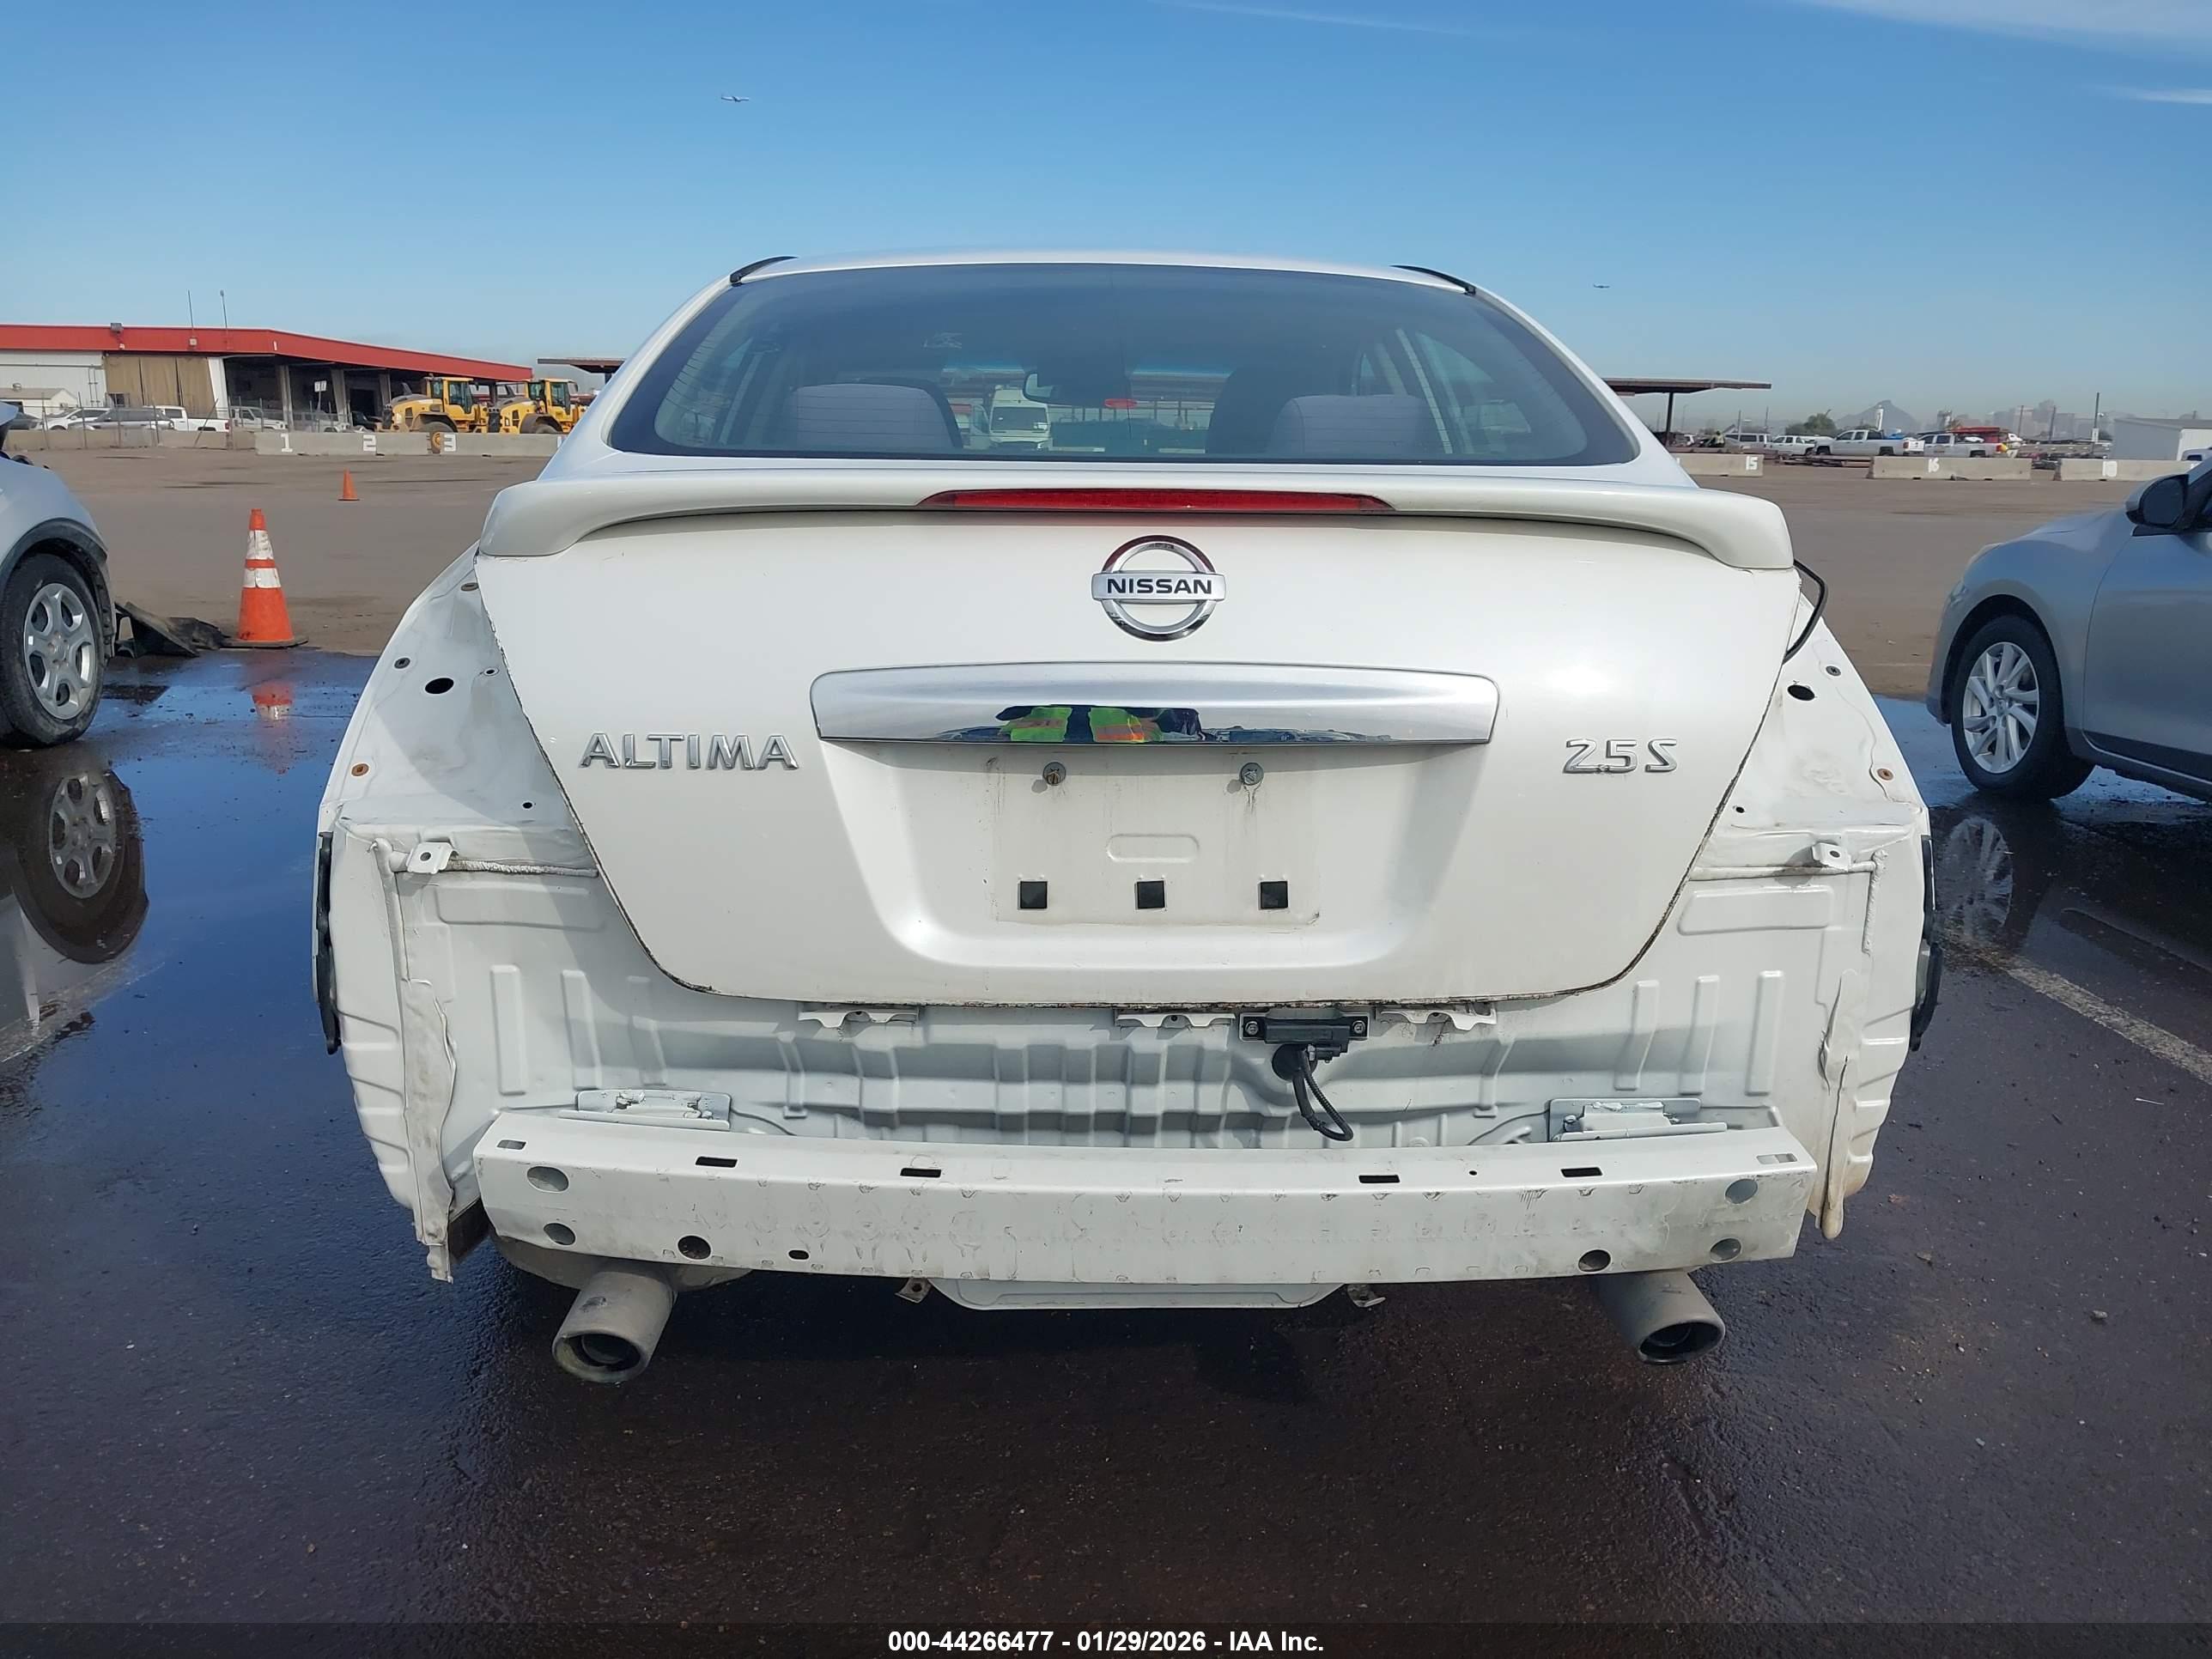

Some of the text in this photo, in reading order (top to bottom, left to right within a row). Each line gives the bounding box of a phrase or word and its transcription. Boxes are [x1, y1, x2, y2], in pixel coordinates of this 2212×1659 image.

[280, 433, 294, 453] 1
[362, 434, 377, 452] 2
[443, 434, 457, 453] 3
[1746, 456, 1759, 471] 15
[1107, 578, 1212, 594] NISSAN
[579, 732, 800, 770] ALTIMA
